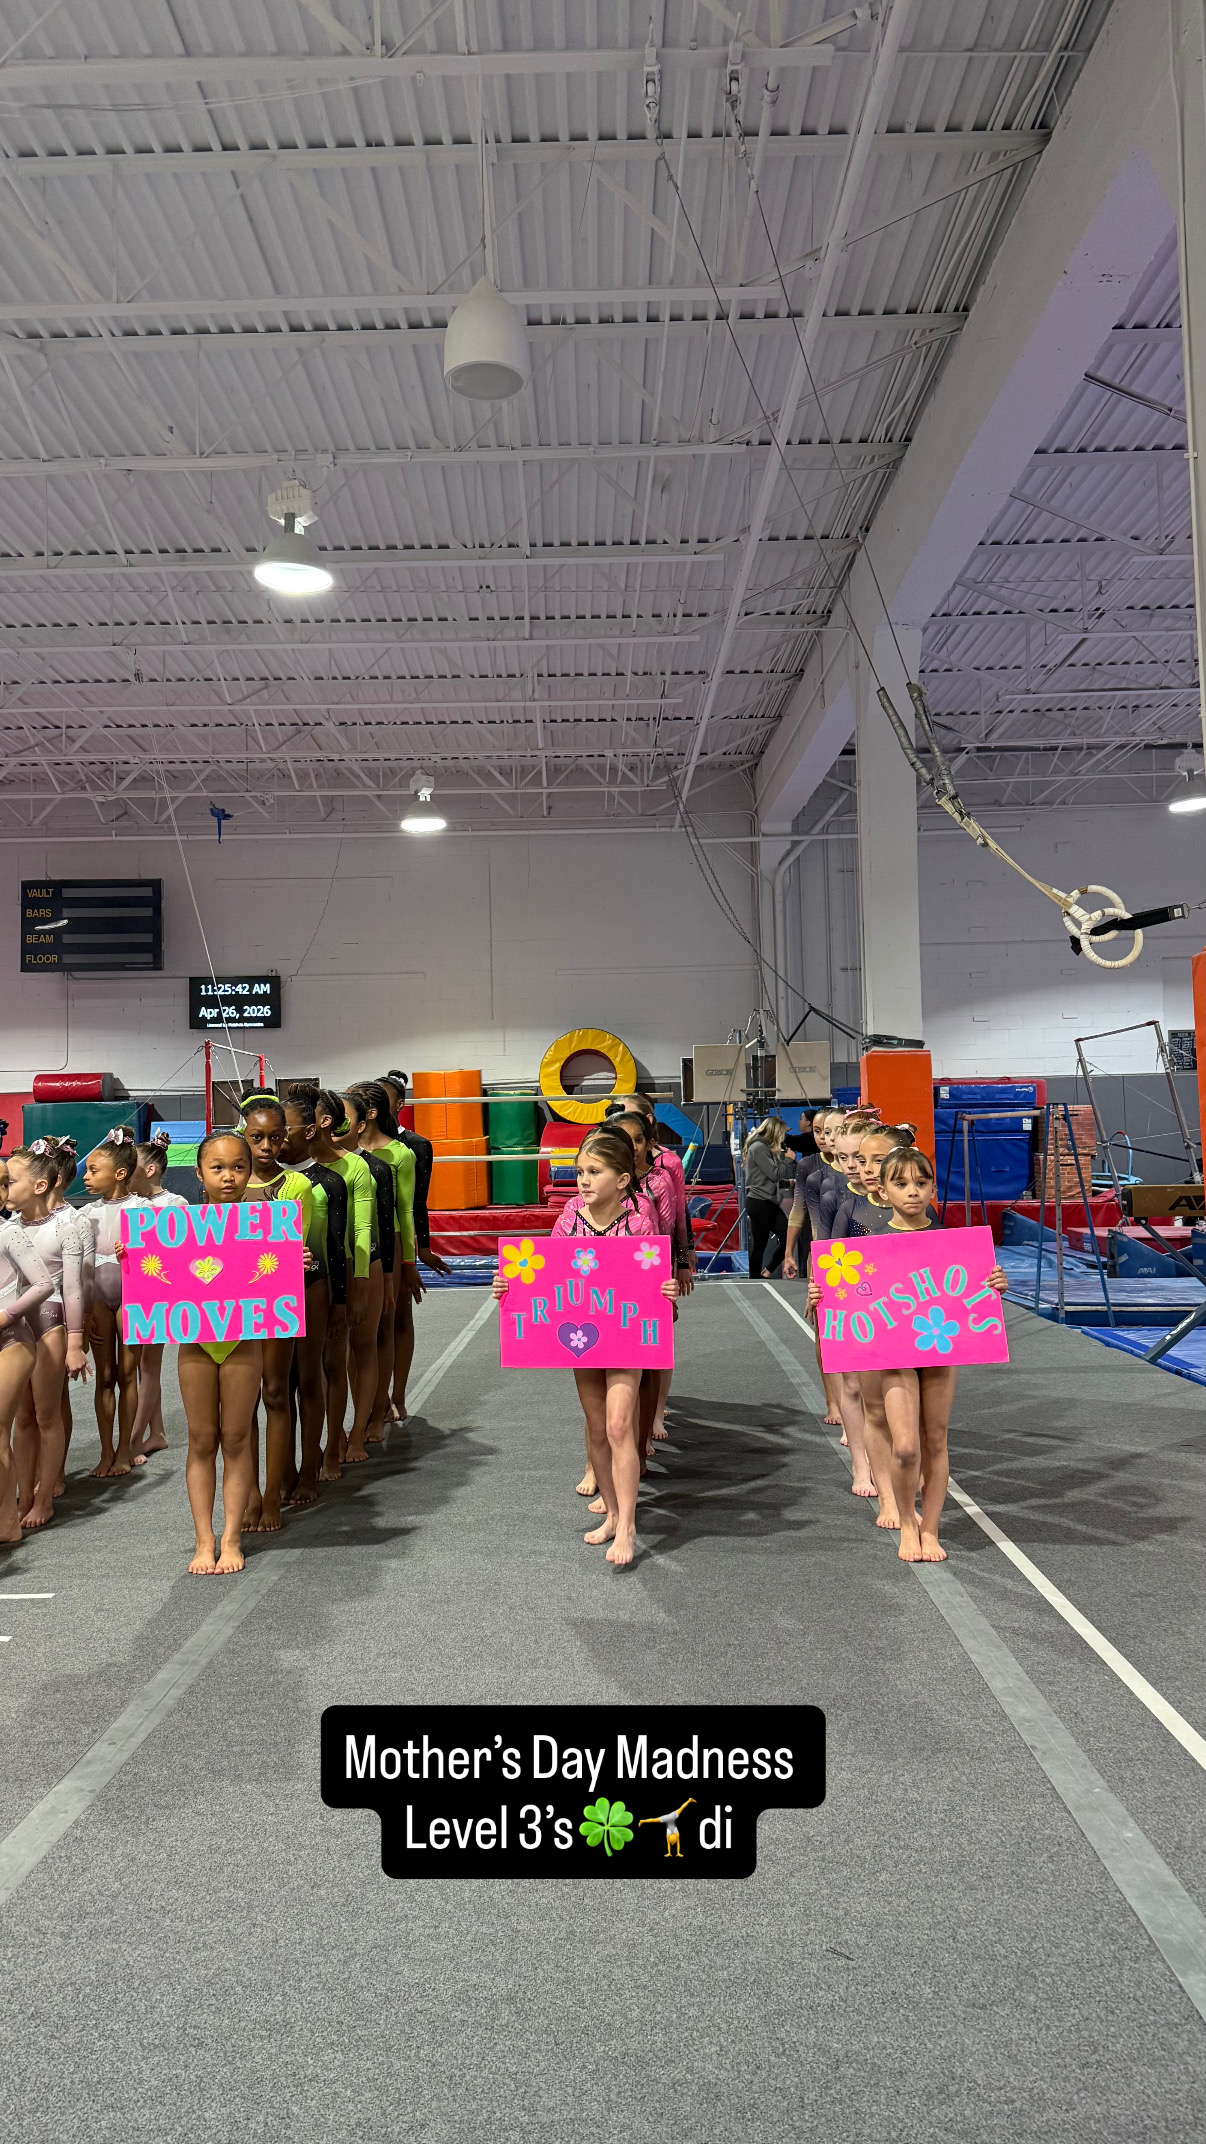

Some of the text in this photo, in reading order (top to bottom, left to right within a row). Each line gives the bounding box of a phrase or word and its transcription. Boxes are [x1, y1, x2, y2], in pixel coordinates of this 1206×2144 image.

[27, 888, 54, 898] VAULT
[26, 908, 52, 918] BARS
[26, 934, 54, 944] BEAM
[26, 954, 58, 964] FLOOR
[200, 983, 271, 995] 11:25:42 AM
[199, 1005, 271, 1020] Apr 26, 2026
[125, 1200, 303, 1249] POWER
[823, 1265, 1002, 1343] HOTSHOTS
[511, 1279, 661, 1346] TRIUMPH
[125, 1295, 300, 1345] MOVES
